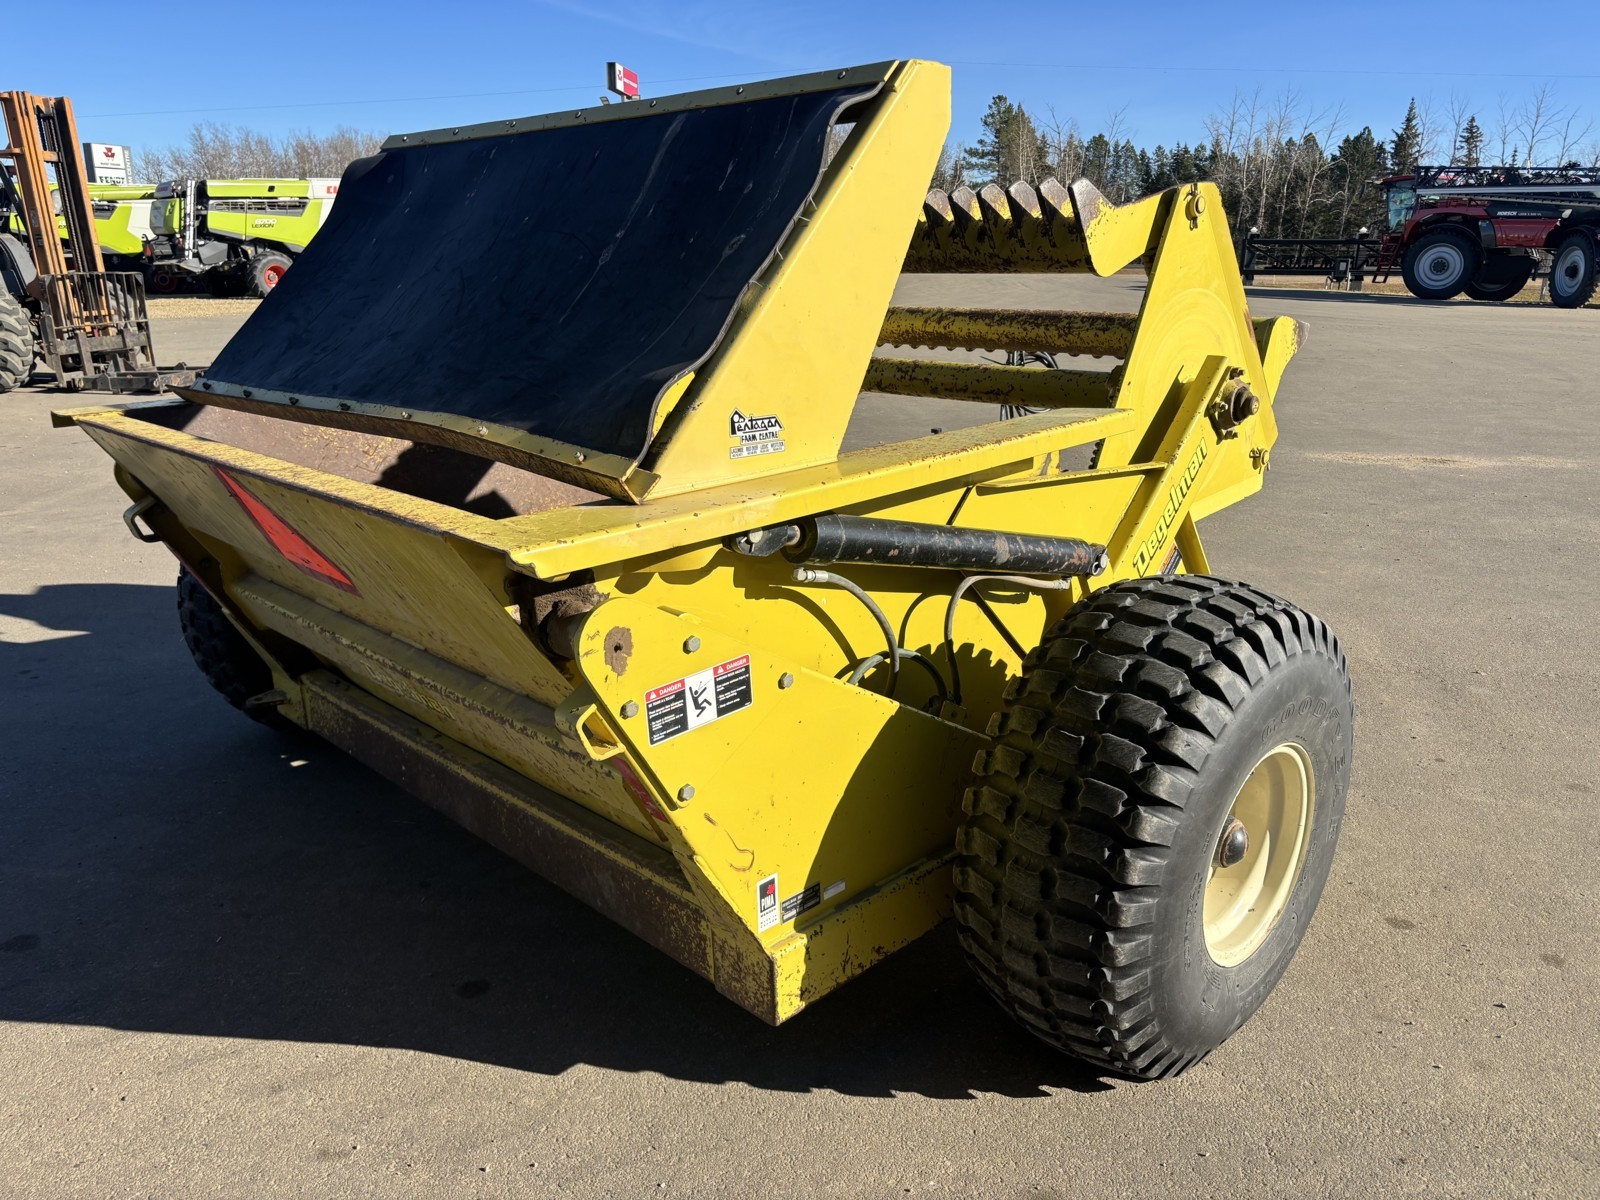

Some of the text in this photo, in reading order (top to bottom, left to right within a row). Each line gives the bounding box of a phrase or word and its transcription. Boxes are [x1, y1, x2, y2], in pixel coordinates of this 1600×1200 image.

[98, 176, 125, 184] FENDT
[730, 410, 783, 435] Pentagon
[741, 430, 779, 443] FARM CENTRE
[1132, 436, 1208, 578] Degelman
[725, 657, 747, 671] DANGER
[659, 682, 683, 696] DANGER
[761, 893, 775, 912] PIMA
